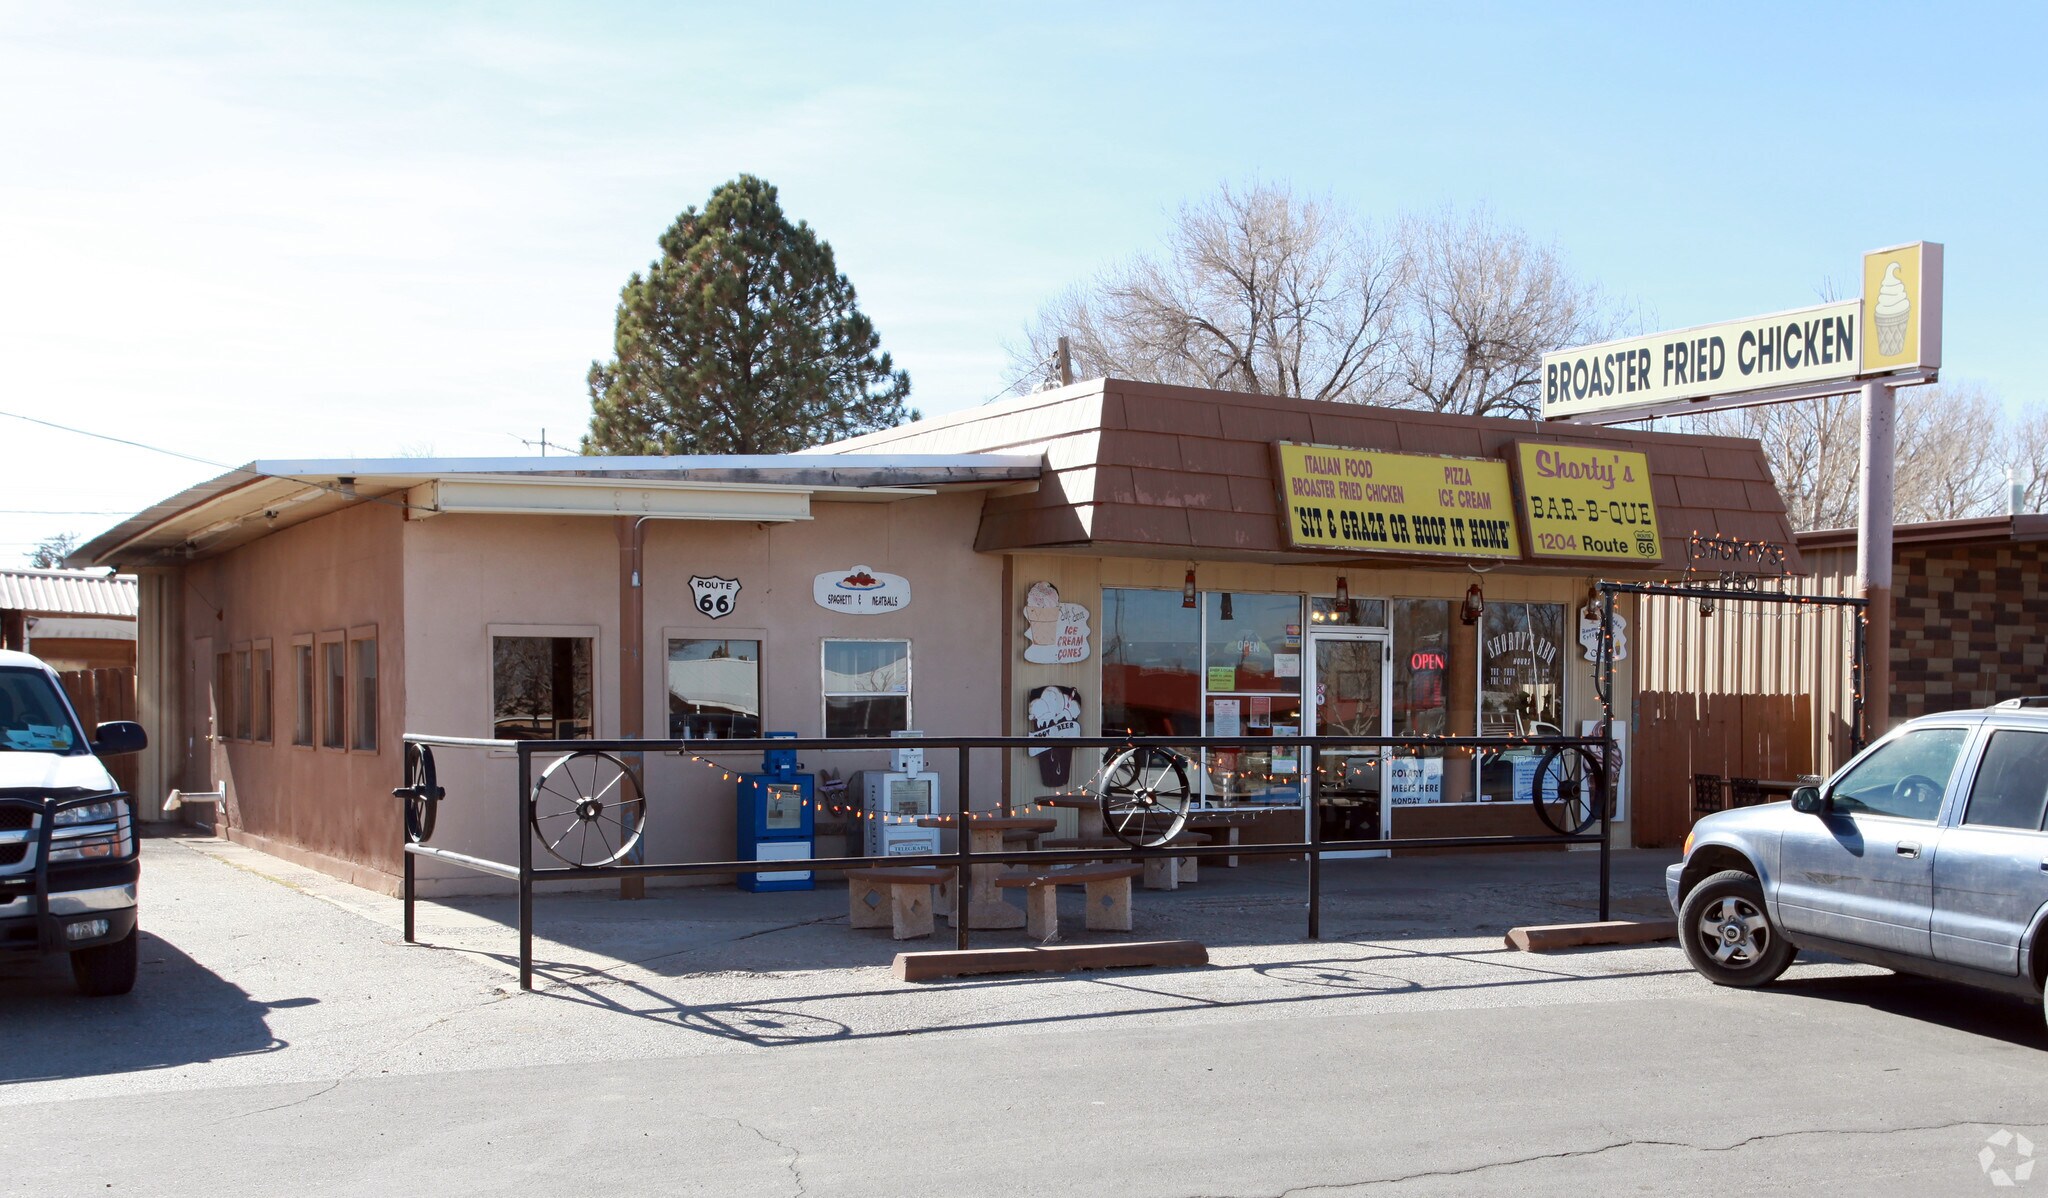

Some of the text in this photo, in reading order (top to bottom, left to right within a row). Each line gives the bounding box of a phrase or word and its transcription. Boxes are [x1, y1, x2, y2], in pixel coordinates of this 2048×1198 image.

[1546, 314, 1855, 405] BROASTER FRIED CHICKEN
[1304, 454, 1373, 479] ITALIAN FOOD
[1535, 449, 1635, 492] Shorty's
[1444, 466, 1473, 487] PIZZA
[1292, 477, 1405, 504] BROASTER FRIED CHICKEN
[1438, 488, 1492, 510] ICE CREAM
[1531, 495, 1652, 527] BAR-B-QUE
[1327, 512, 1338, 539] &
[1341, 512, 1387, 542] GRAZE
[1390, 516, 1411, 544] OR
[1414, 516, 1447, 546] HOOF
[1450, 519, 1465, 547] IT
[1537, 532, 1629, 554] 1204 Route
[1638, 542, 1655, 554] 66
[697, 580, 733, 591] ROUTE
[699, 594, 729, 613] 66
[827, 594, 853, 605] SPAGHETTI
[1064, 626, 1079, 635] ICE
[1057, 635, 1084, 647] CREAM
[1238, 640, 1260, 653] OPEN
[1487, 631, 1535, 659] SHORTY'S
[1537, 637, 1557, 664] BBQ
[1057, 647, 1083, 661] CONES
[1411, 653, 1444, 670] OPEN
[1513, 658, 1531, 666] HOURS
[1056, 722, 1074, 731] BEER
[1391, 769, 1424, 778] ROTARY
[1391, 784, 1439, 793] MEETS HERE
